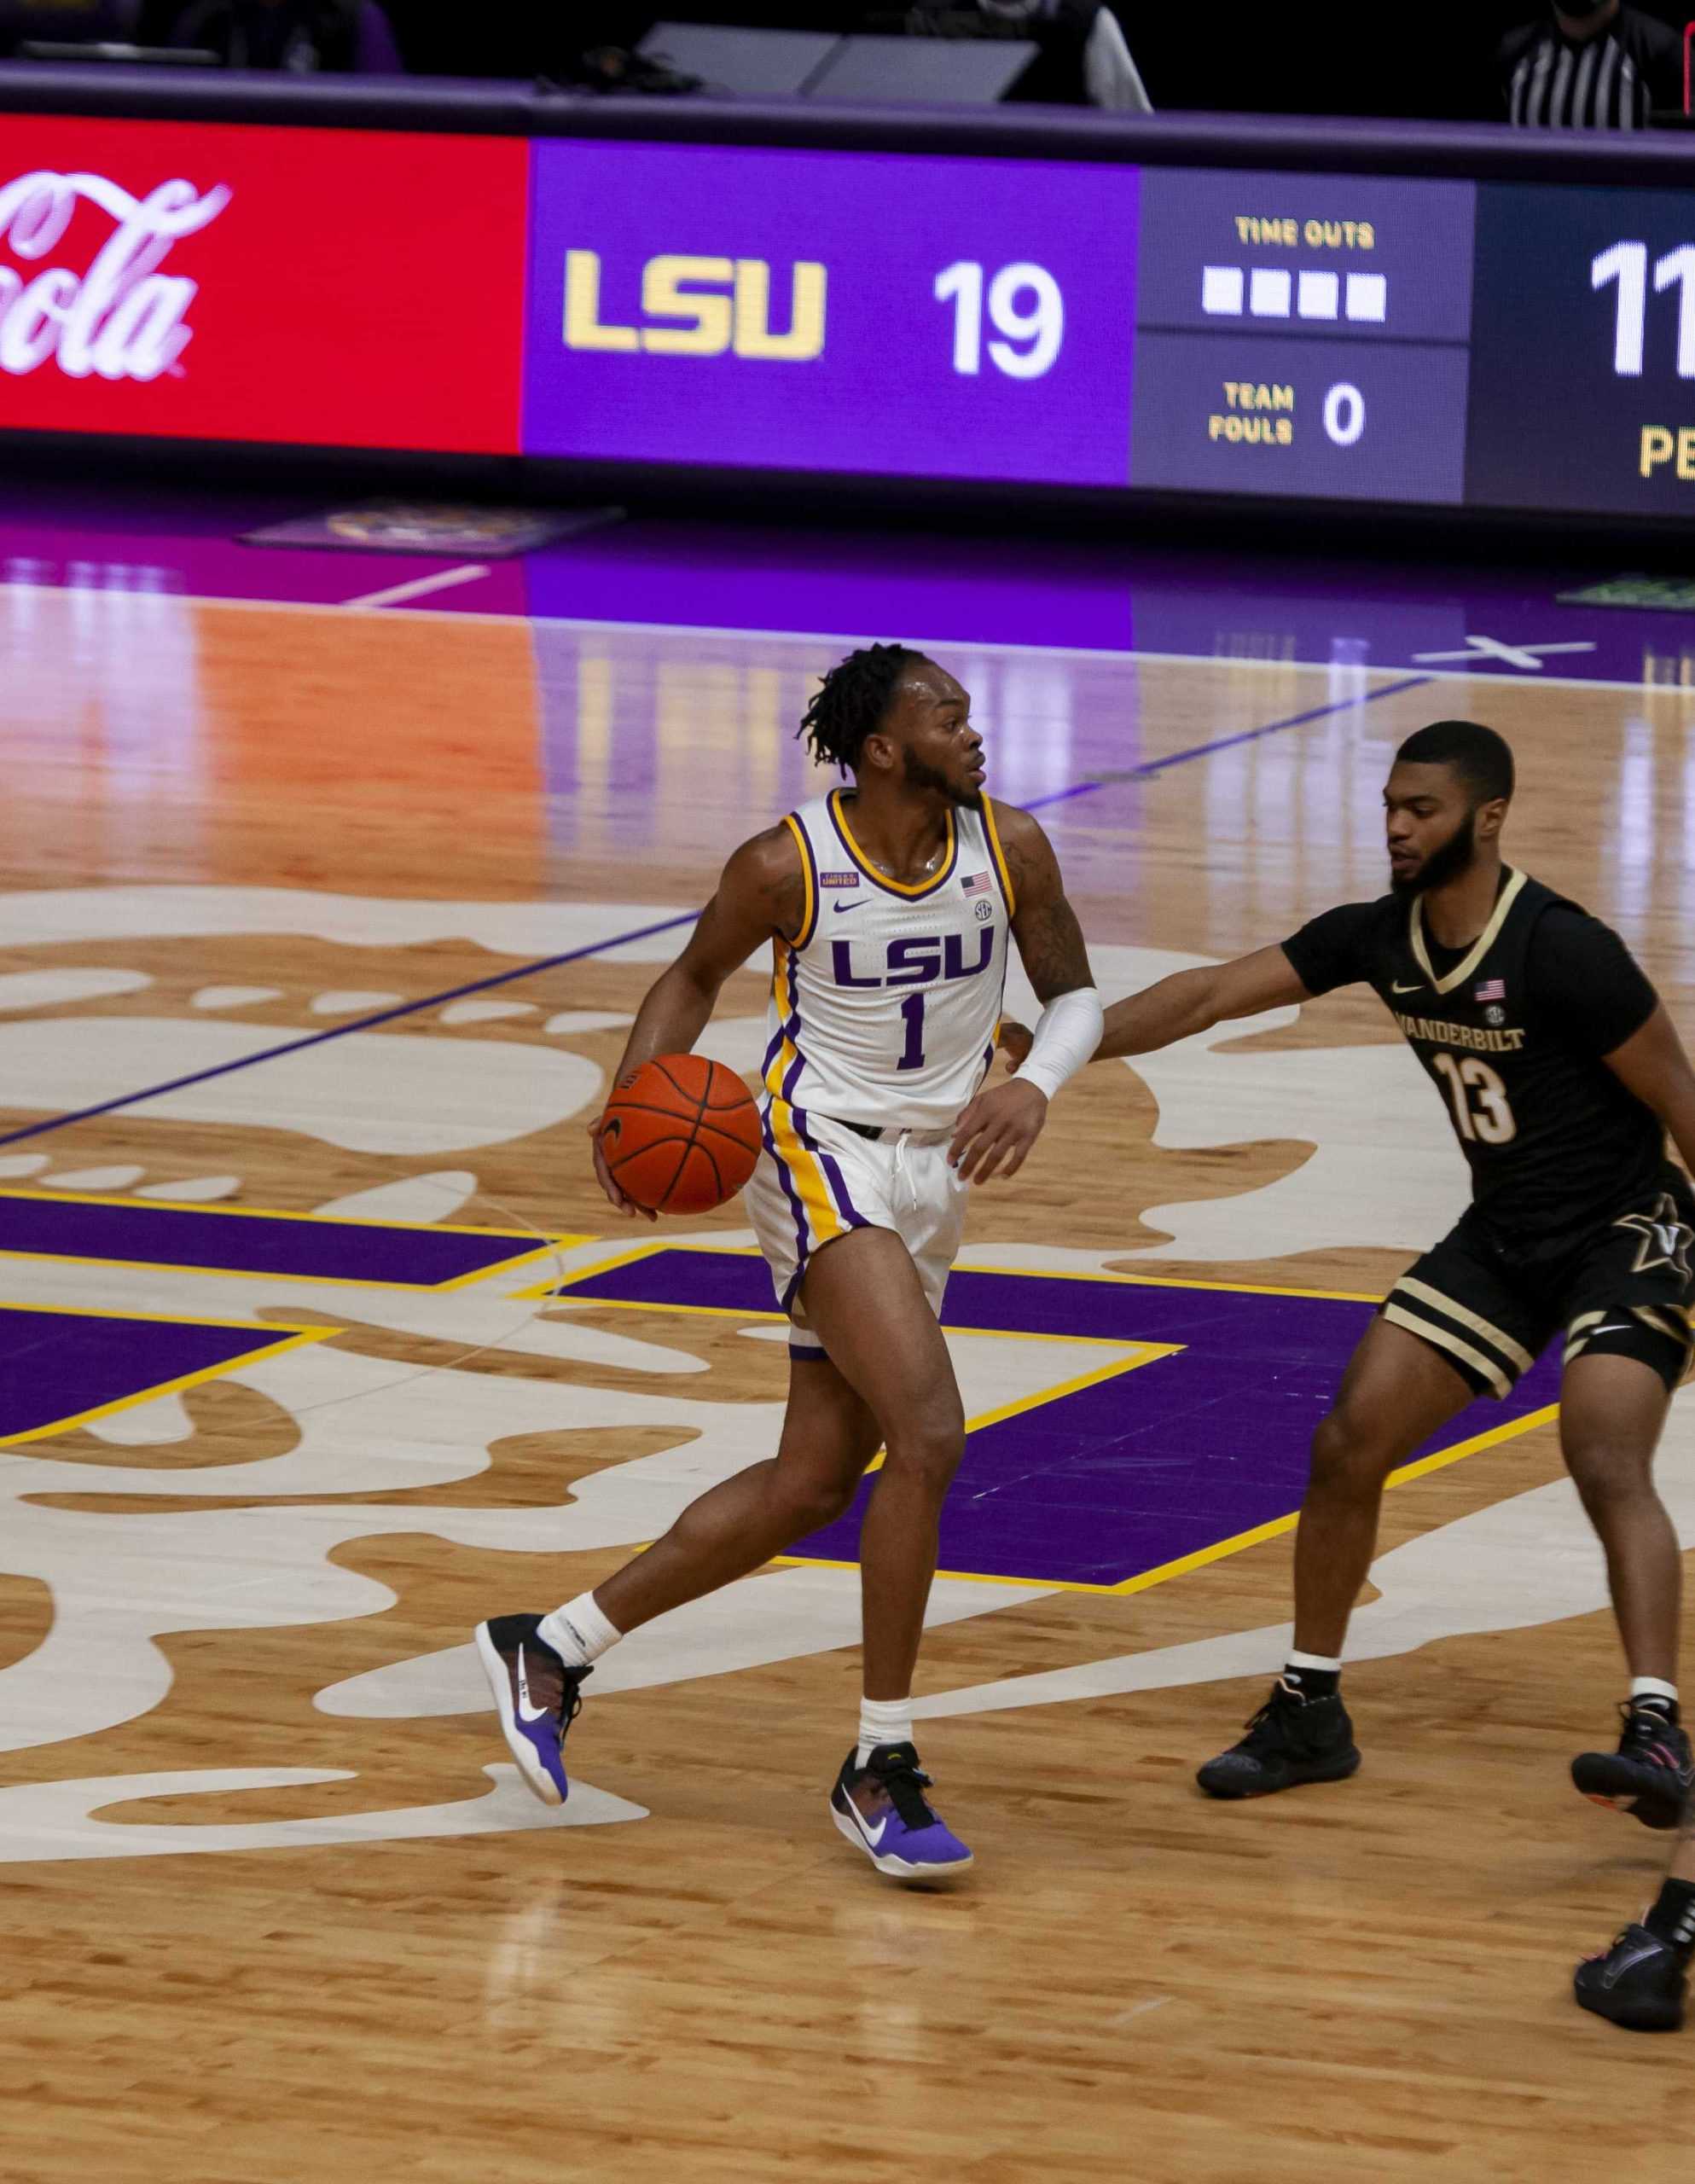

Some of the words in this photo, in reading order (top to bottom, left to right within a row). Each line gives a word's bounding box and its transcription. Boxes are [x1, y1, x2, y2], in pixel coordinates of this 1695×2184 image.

[1234, 216, 1298, 247] TIME
[1303, 219, 1375, 251] OUTS
[564, 250, 827, 361] LSU
[935, 261, 1064, 379] 19
[1591, 239, 1695, 380] 11
[1222, 381, 1293, 412] TEAM
[1324, 382, 1365, 446] 0
[1209, 415, 1292, 446] FOULS
[1640, 424, 1695, 480] PE
[832, 926, 995, 987] LSU
[897, 993, 926, 1071] 1
[1433, 1052, 1517, 1144] 13
